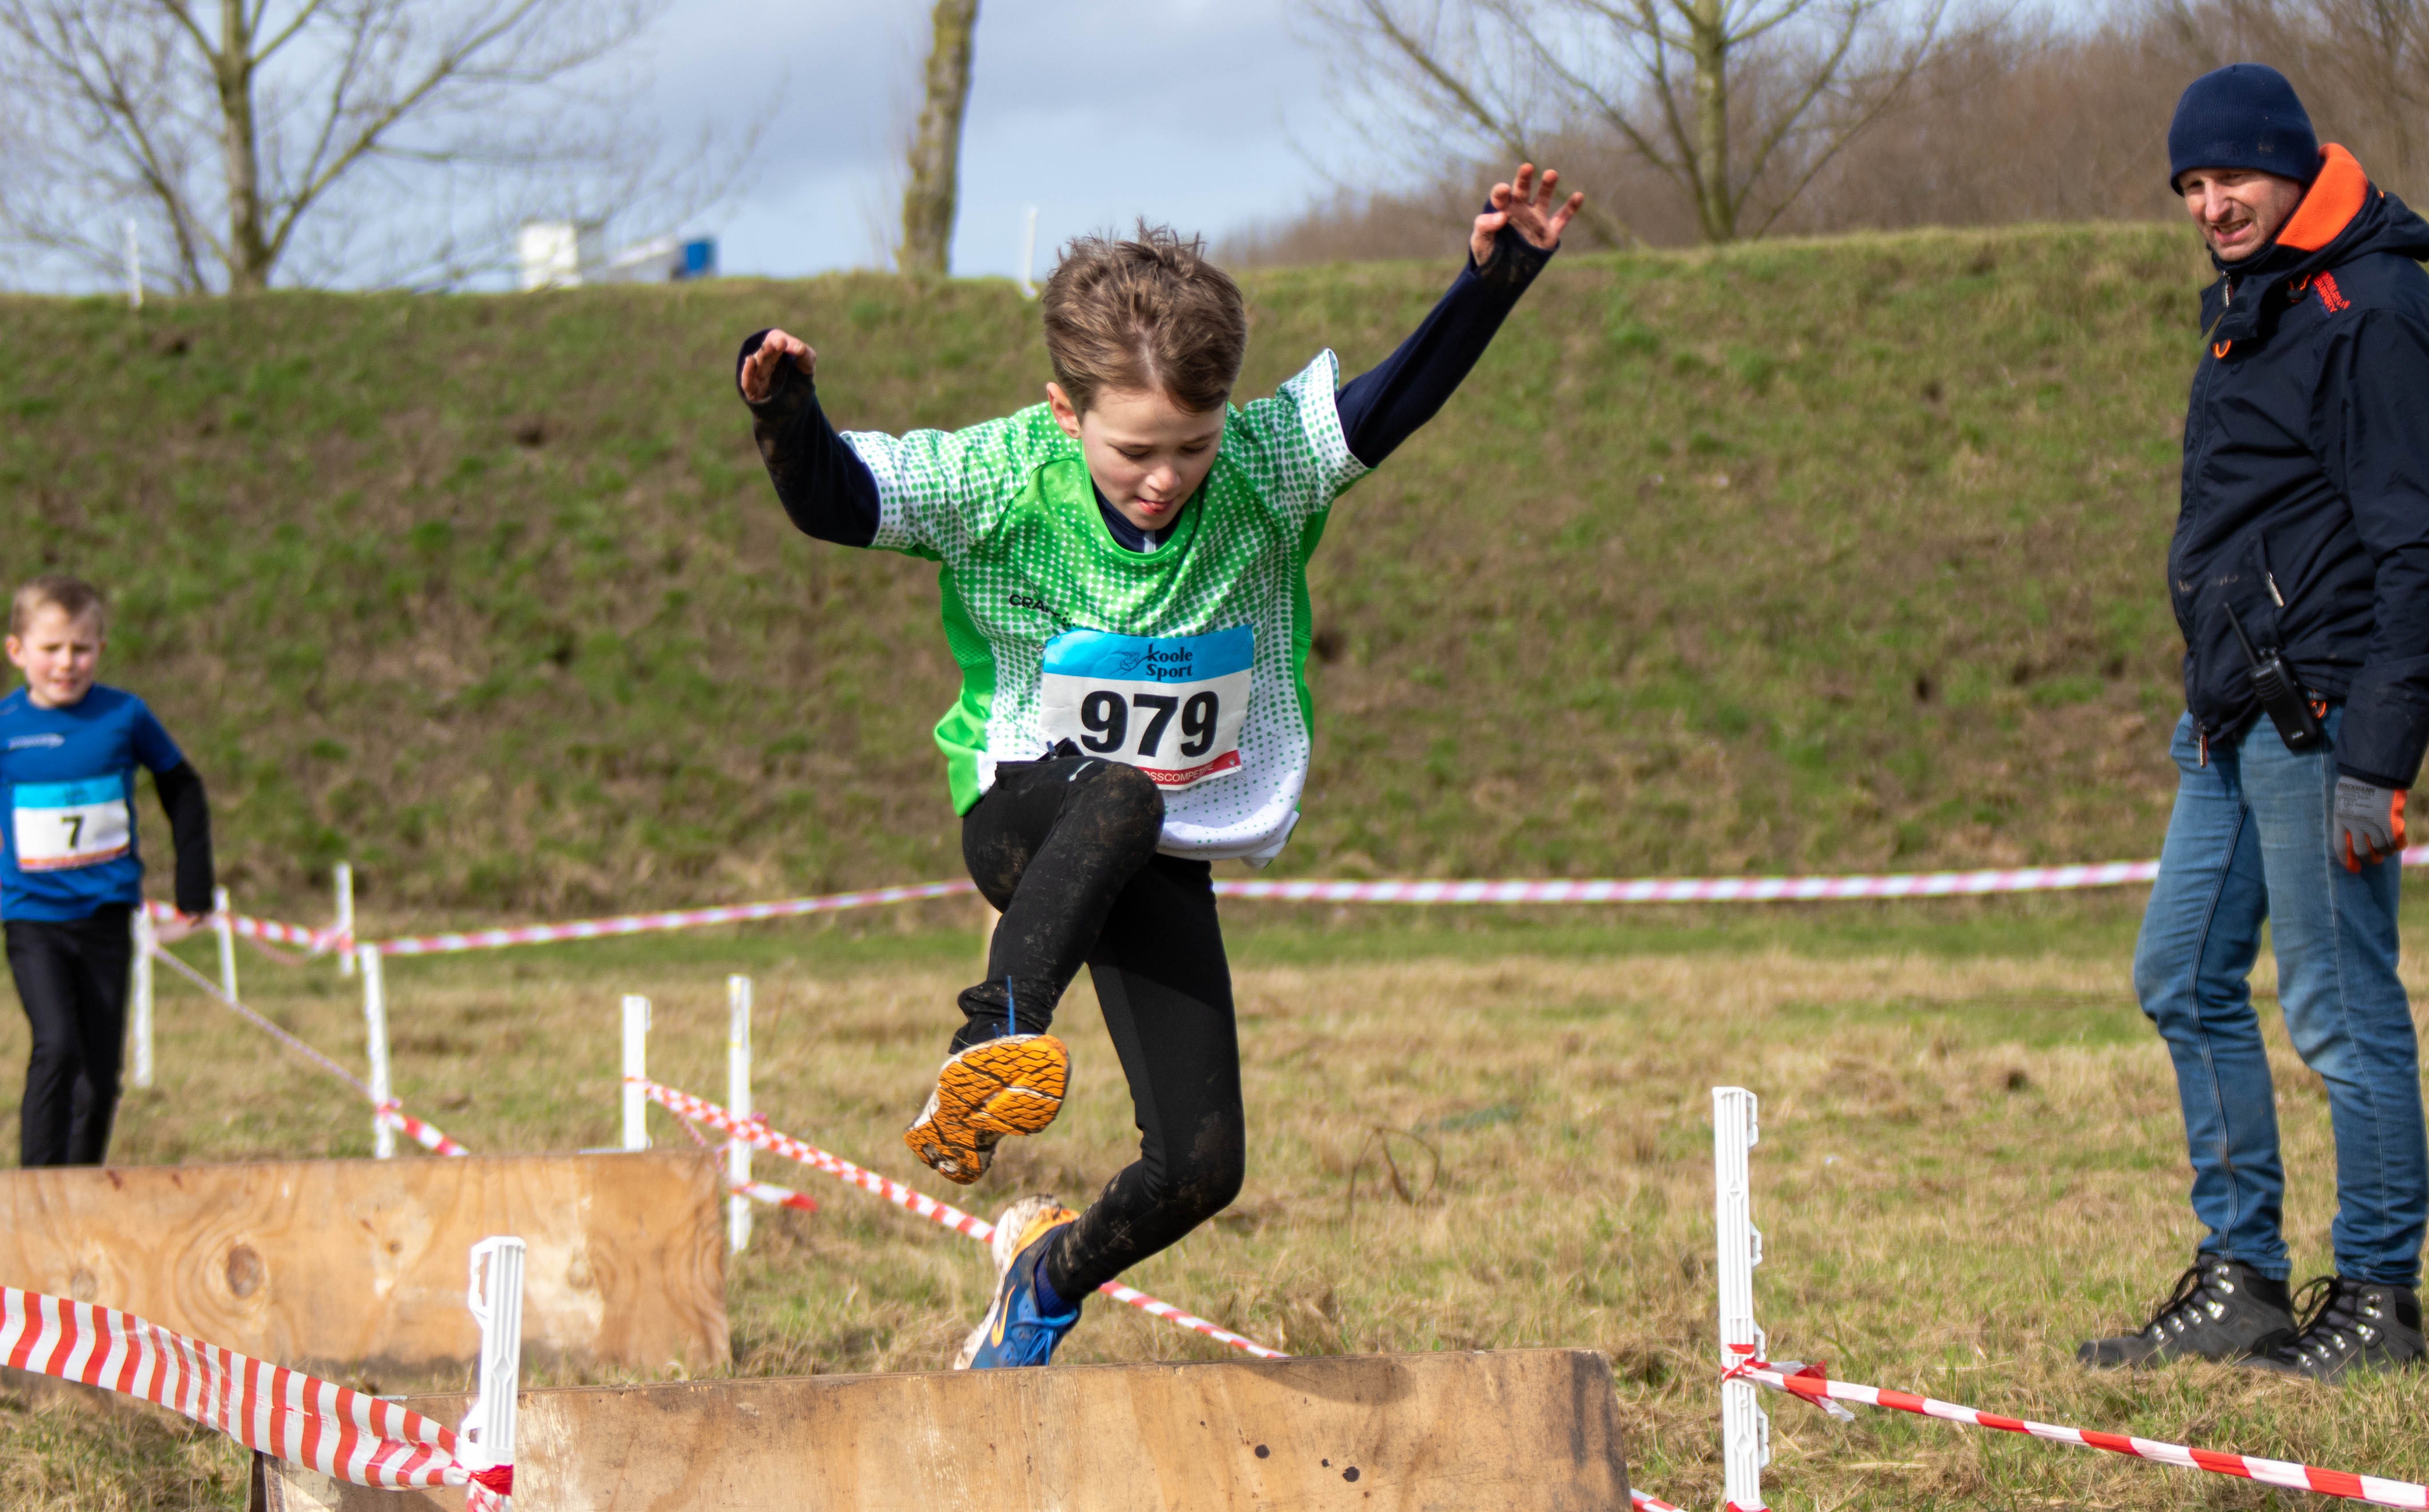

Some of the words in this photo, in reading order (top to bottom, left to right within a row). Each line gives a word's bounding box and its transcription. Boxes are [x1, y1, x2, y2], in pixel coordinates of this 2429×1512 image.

[1146, 663, 1193, 681] Sport
[1080, 690, 1219, 758] 979
[60, 815, 83, 849] 7
